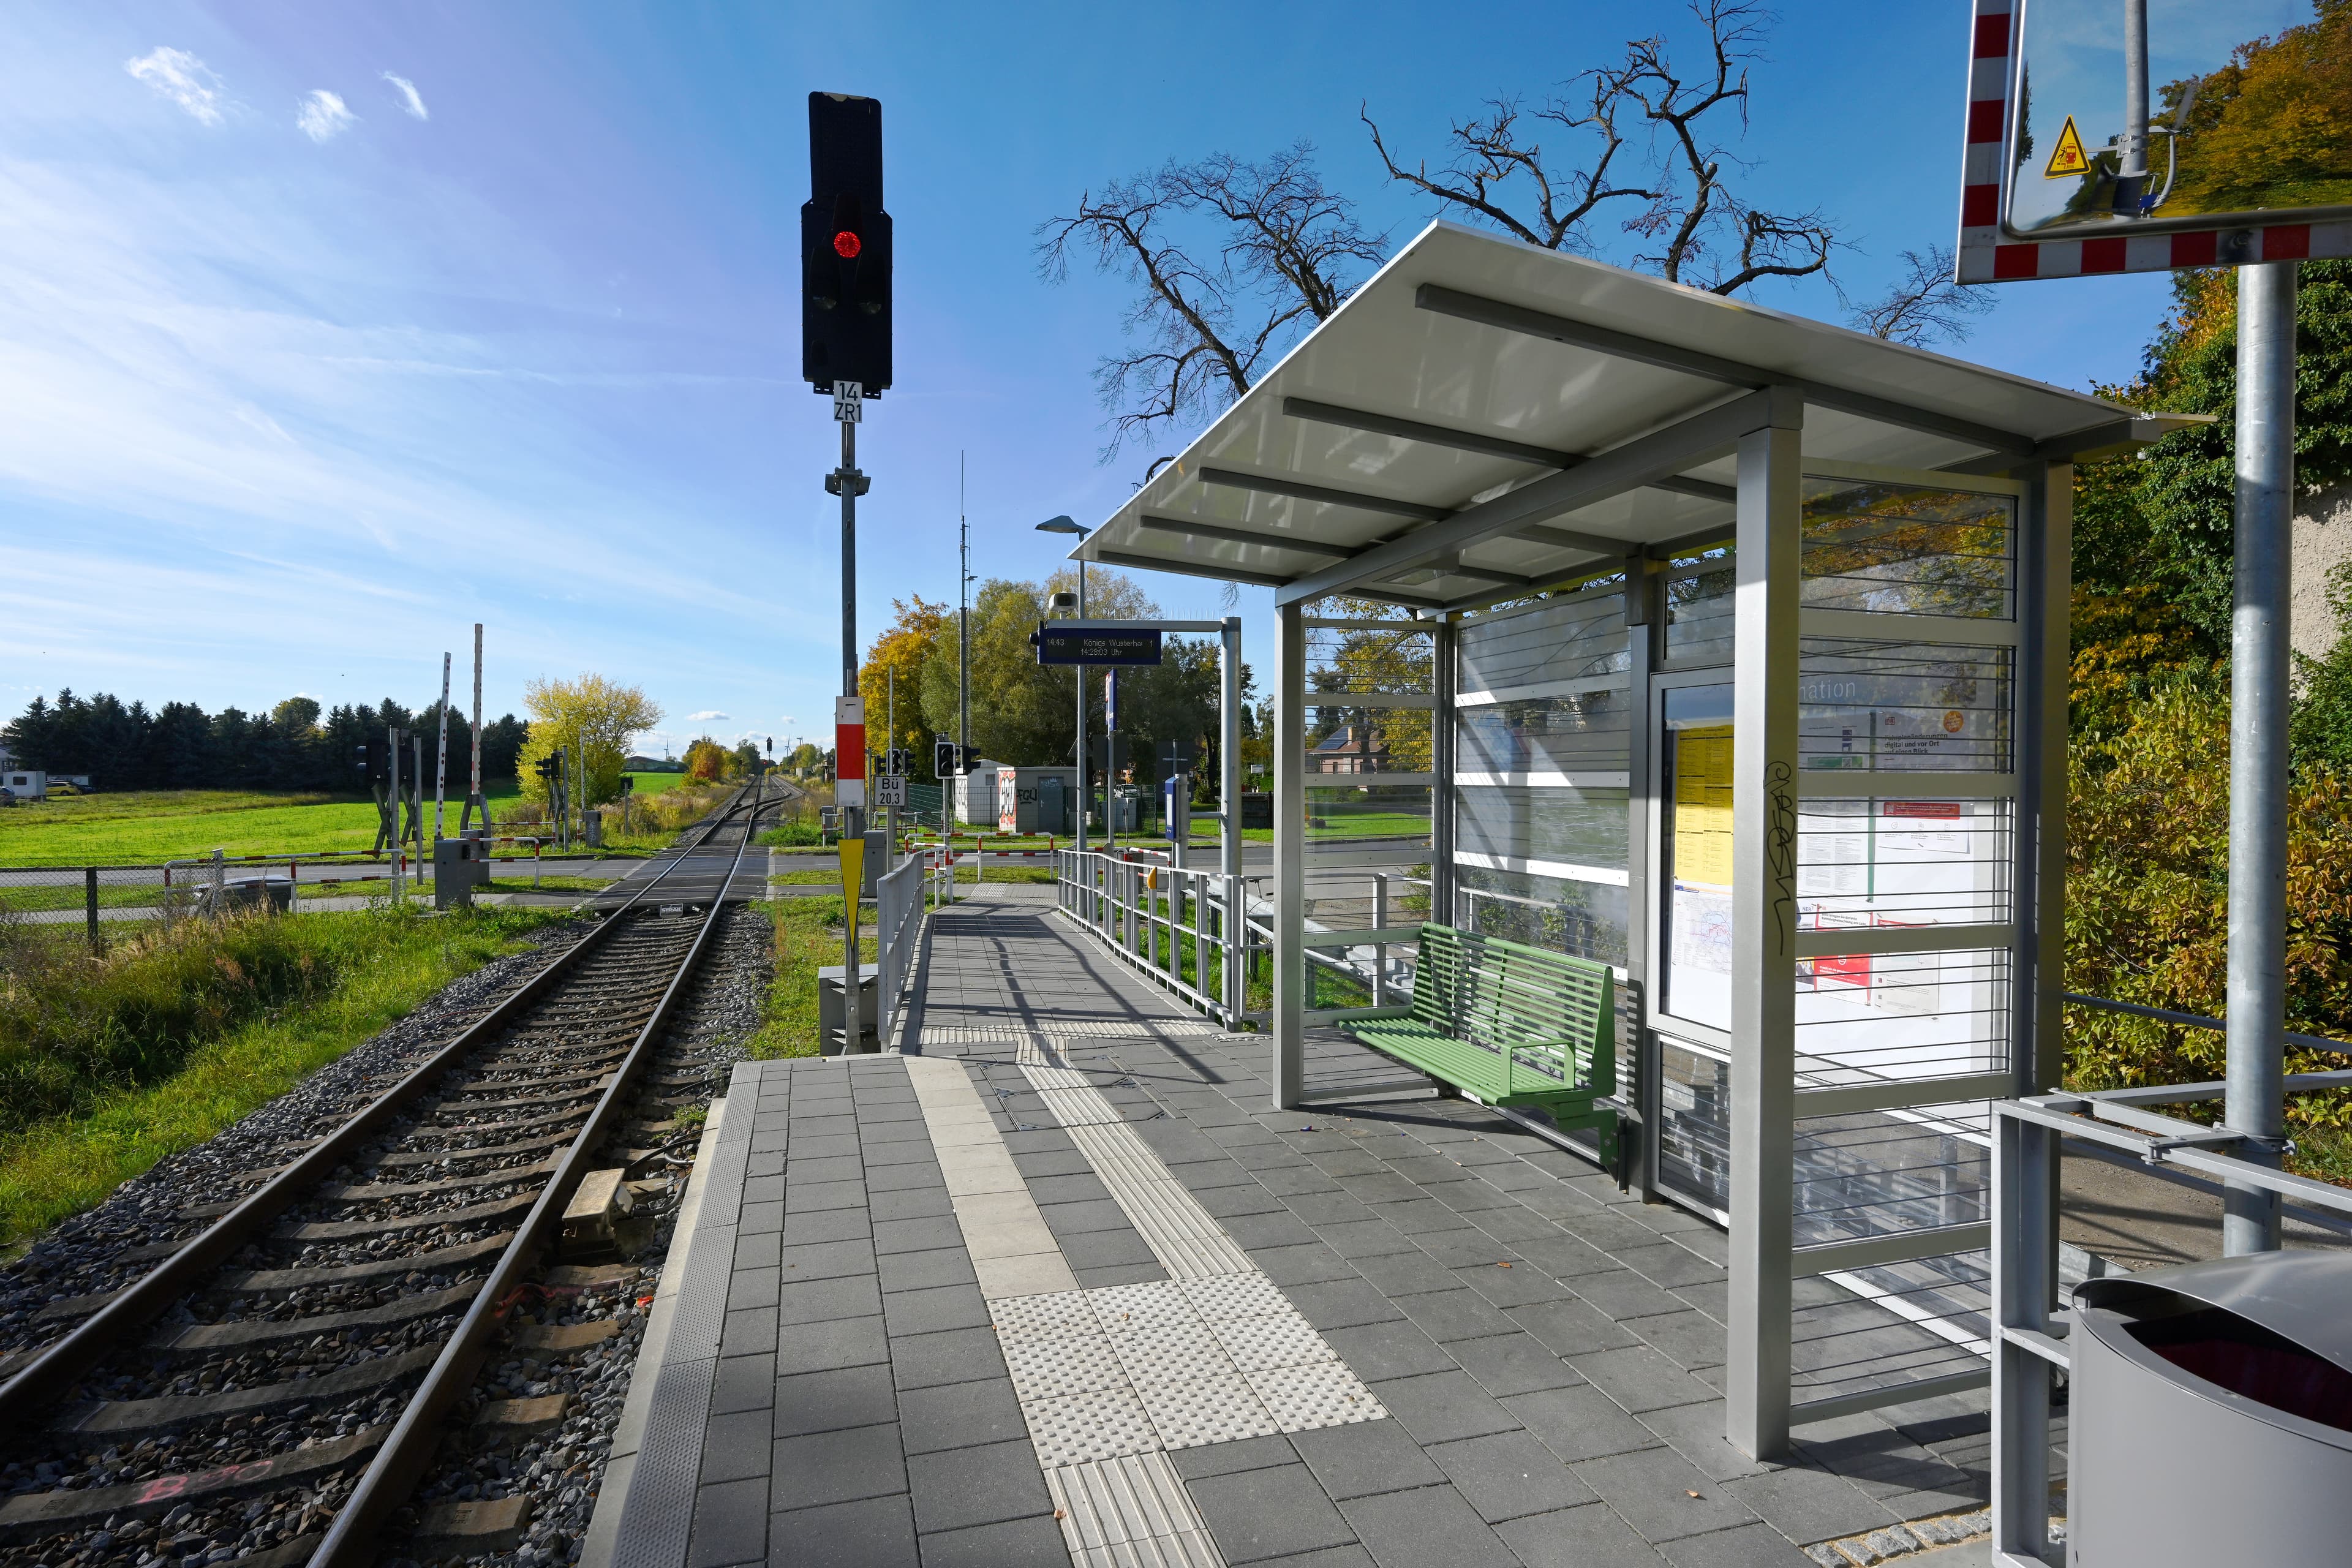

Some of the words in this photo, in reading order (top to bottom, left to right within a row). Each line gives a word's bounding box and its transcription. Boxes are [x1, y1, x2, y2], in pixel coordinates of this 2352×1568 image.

[839, 382, 858, 401] 14
[834, 402, 861, 421] ZR1
[1084, 639, 1106, 648] Königs
[882, 778, 899, 789] Bü
[880, 793, 900, 805] 20,3
